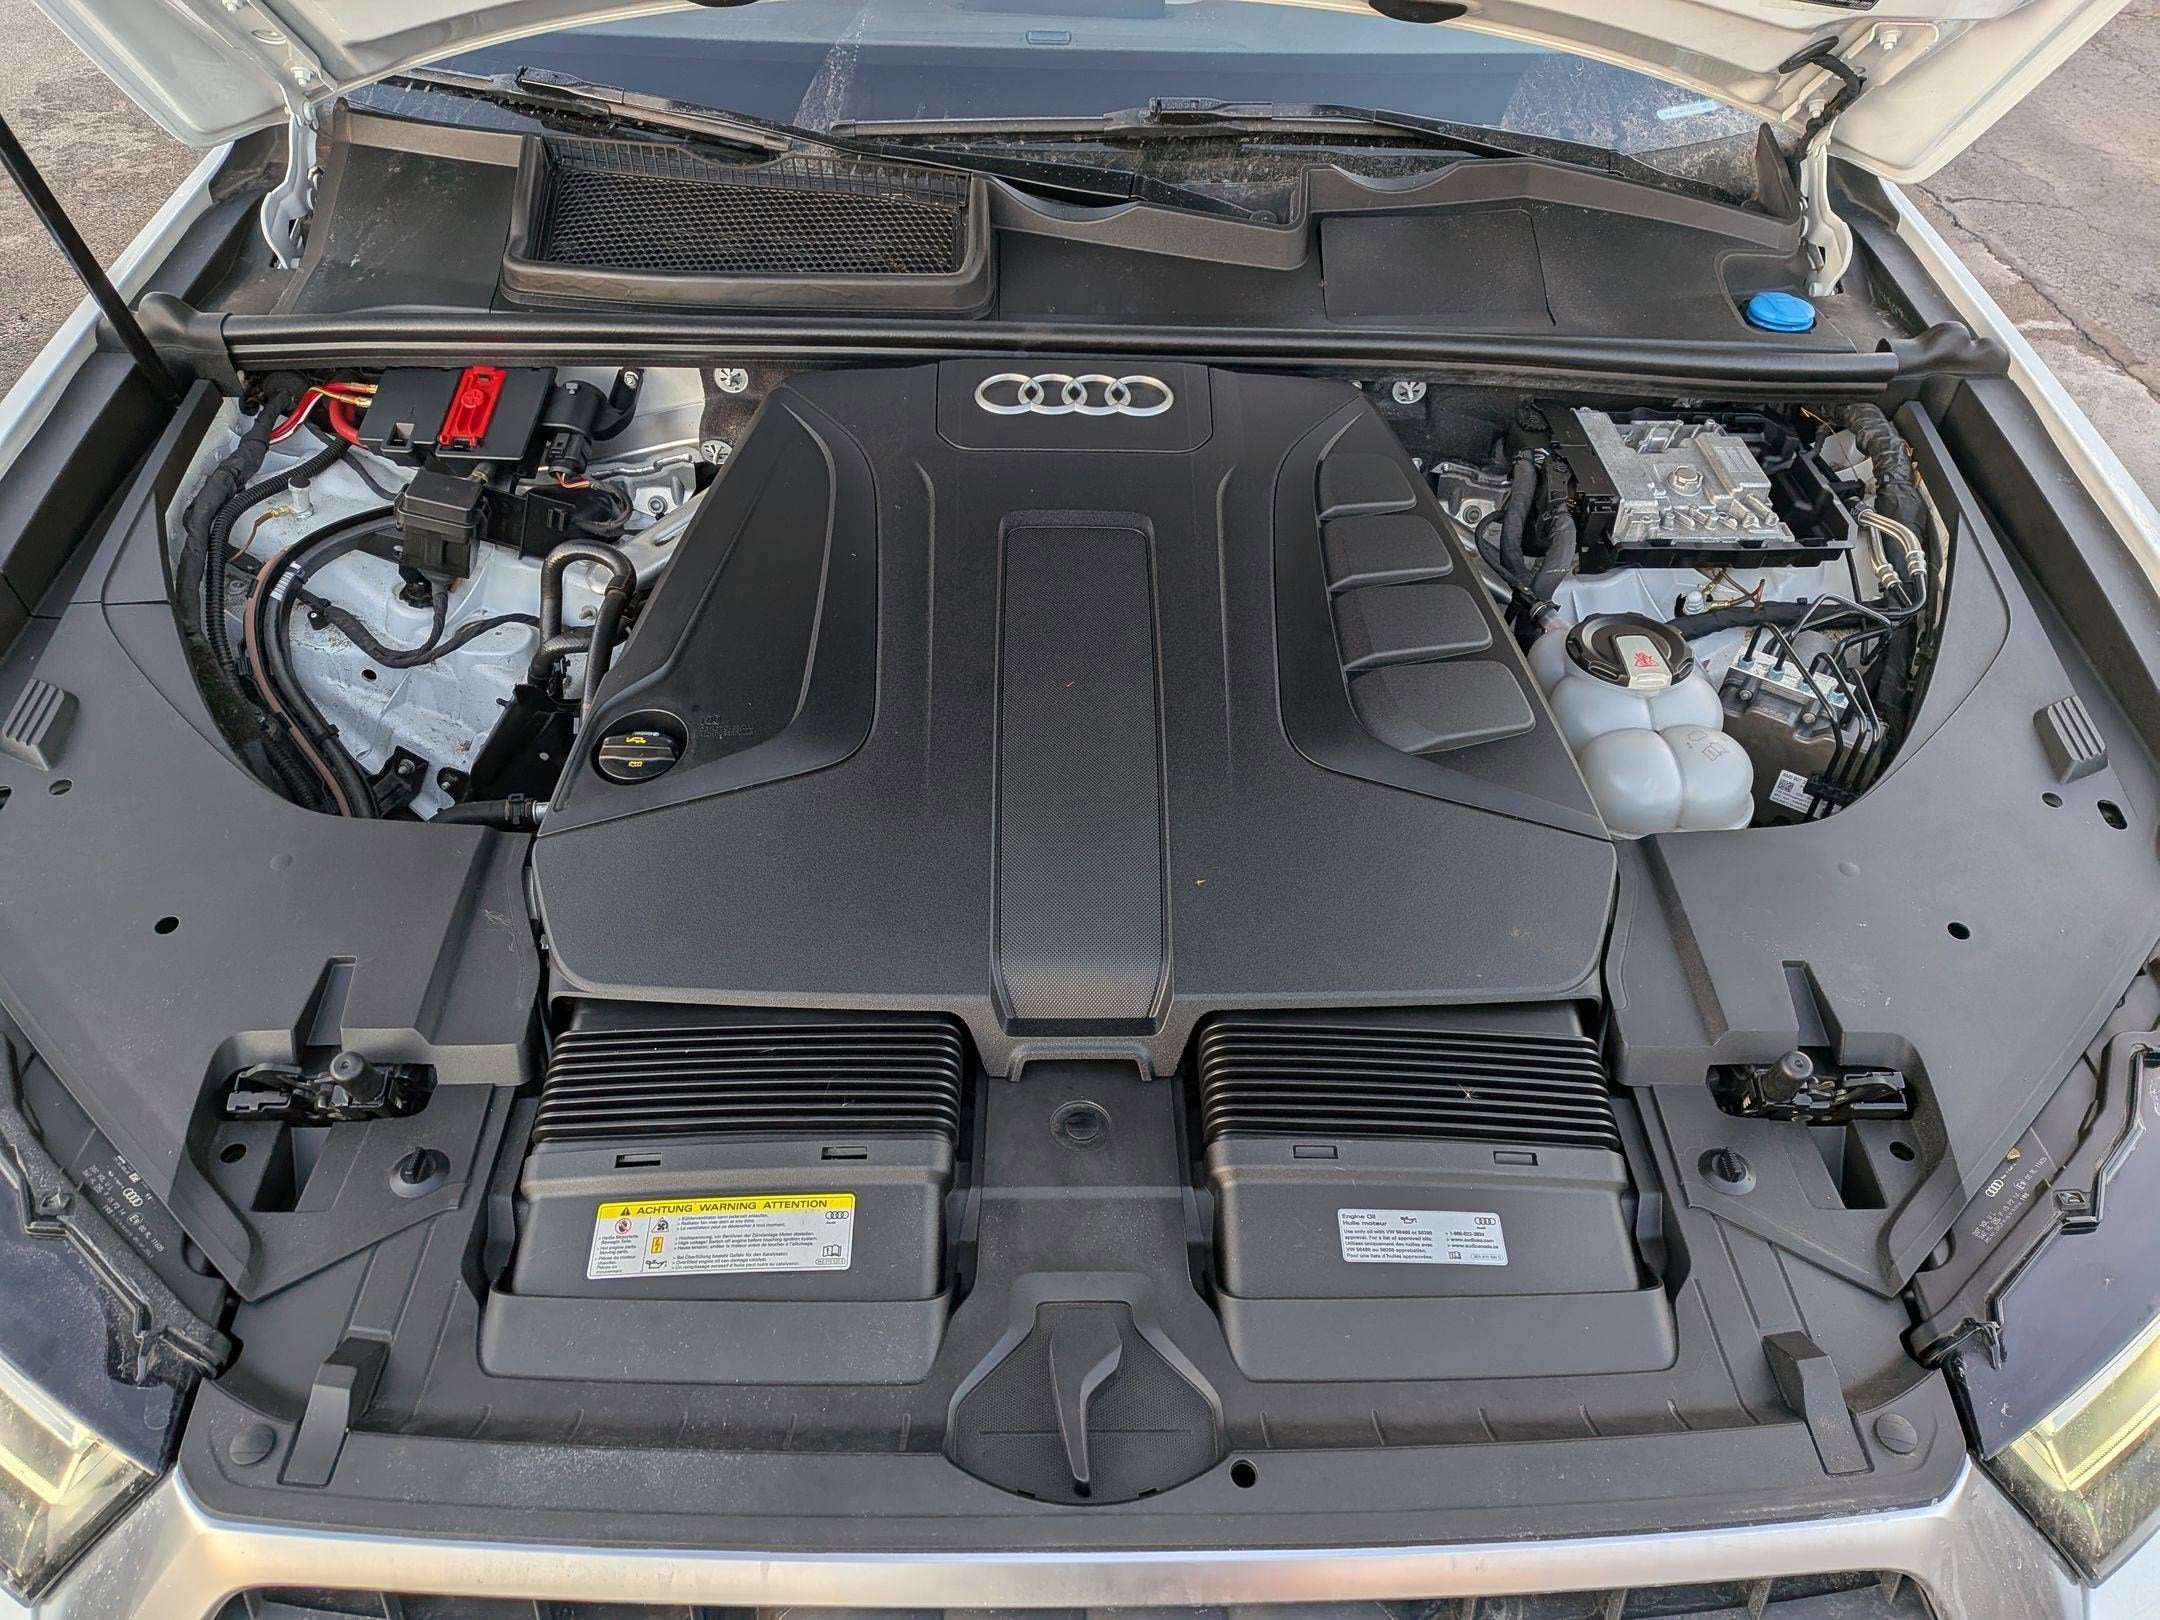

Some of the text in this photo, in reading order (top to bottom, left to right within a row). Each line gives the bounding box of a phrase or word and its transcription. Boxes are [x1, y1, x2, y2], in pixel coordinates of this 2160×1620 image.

[637, 1200, 827, 1214] ACHTUNG WARNING ATTENTION
